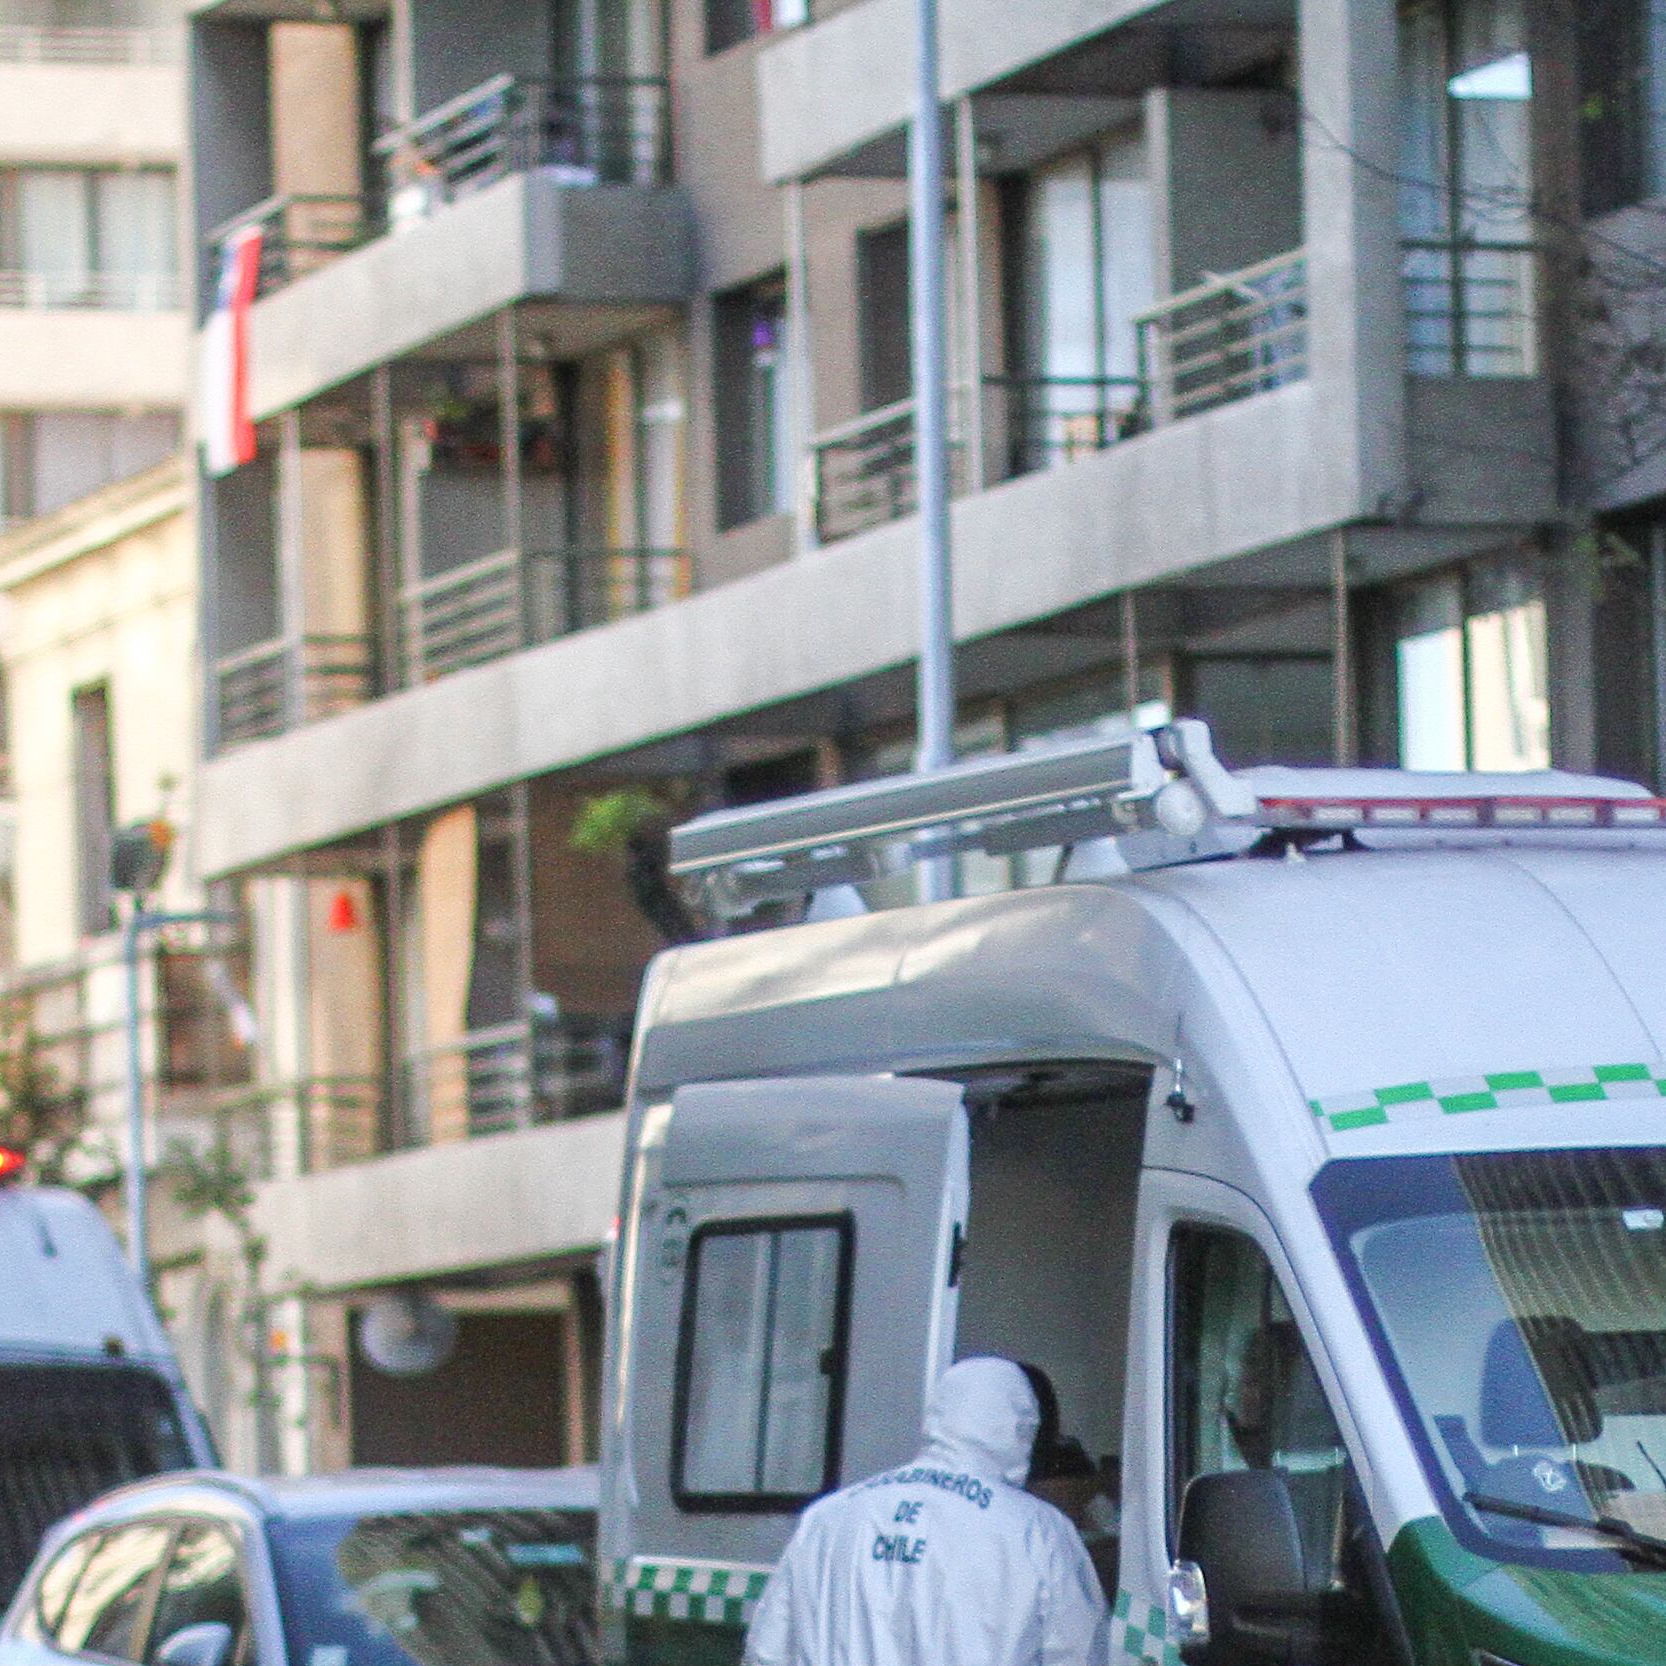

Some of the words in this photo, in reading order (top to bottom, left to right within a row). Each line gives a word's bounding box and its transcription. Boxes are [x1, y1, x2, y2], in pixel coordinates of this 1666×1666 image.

[847, 1467, 994, 1510] ABINEROS
[893, 1500, 924, 1524] DE
[871, 1534, 927, 1564] CHILE
